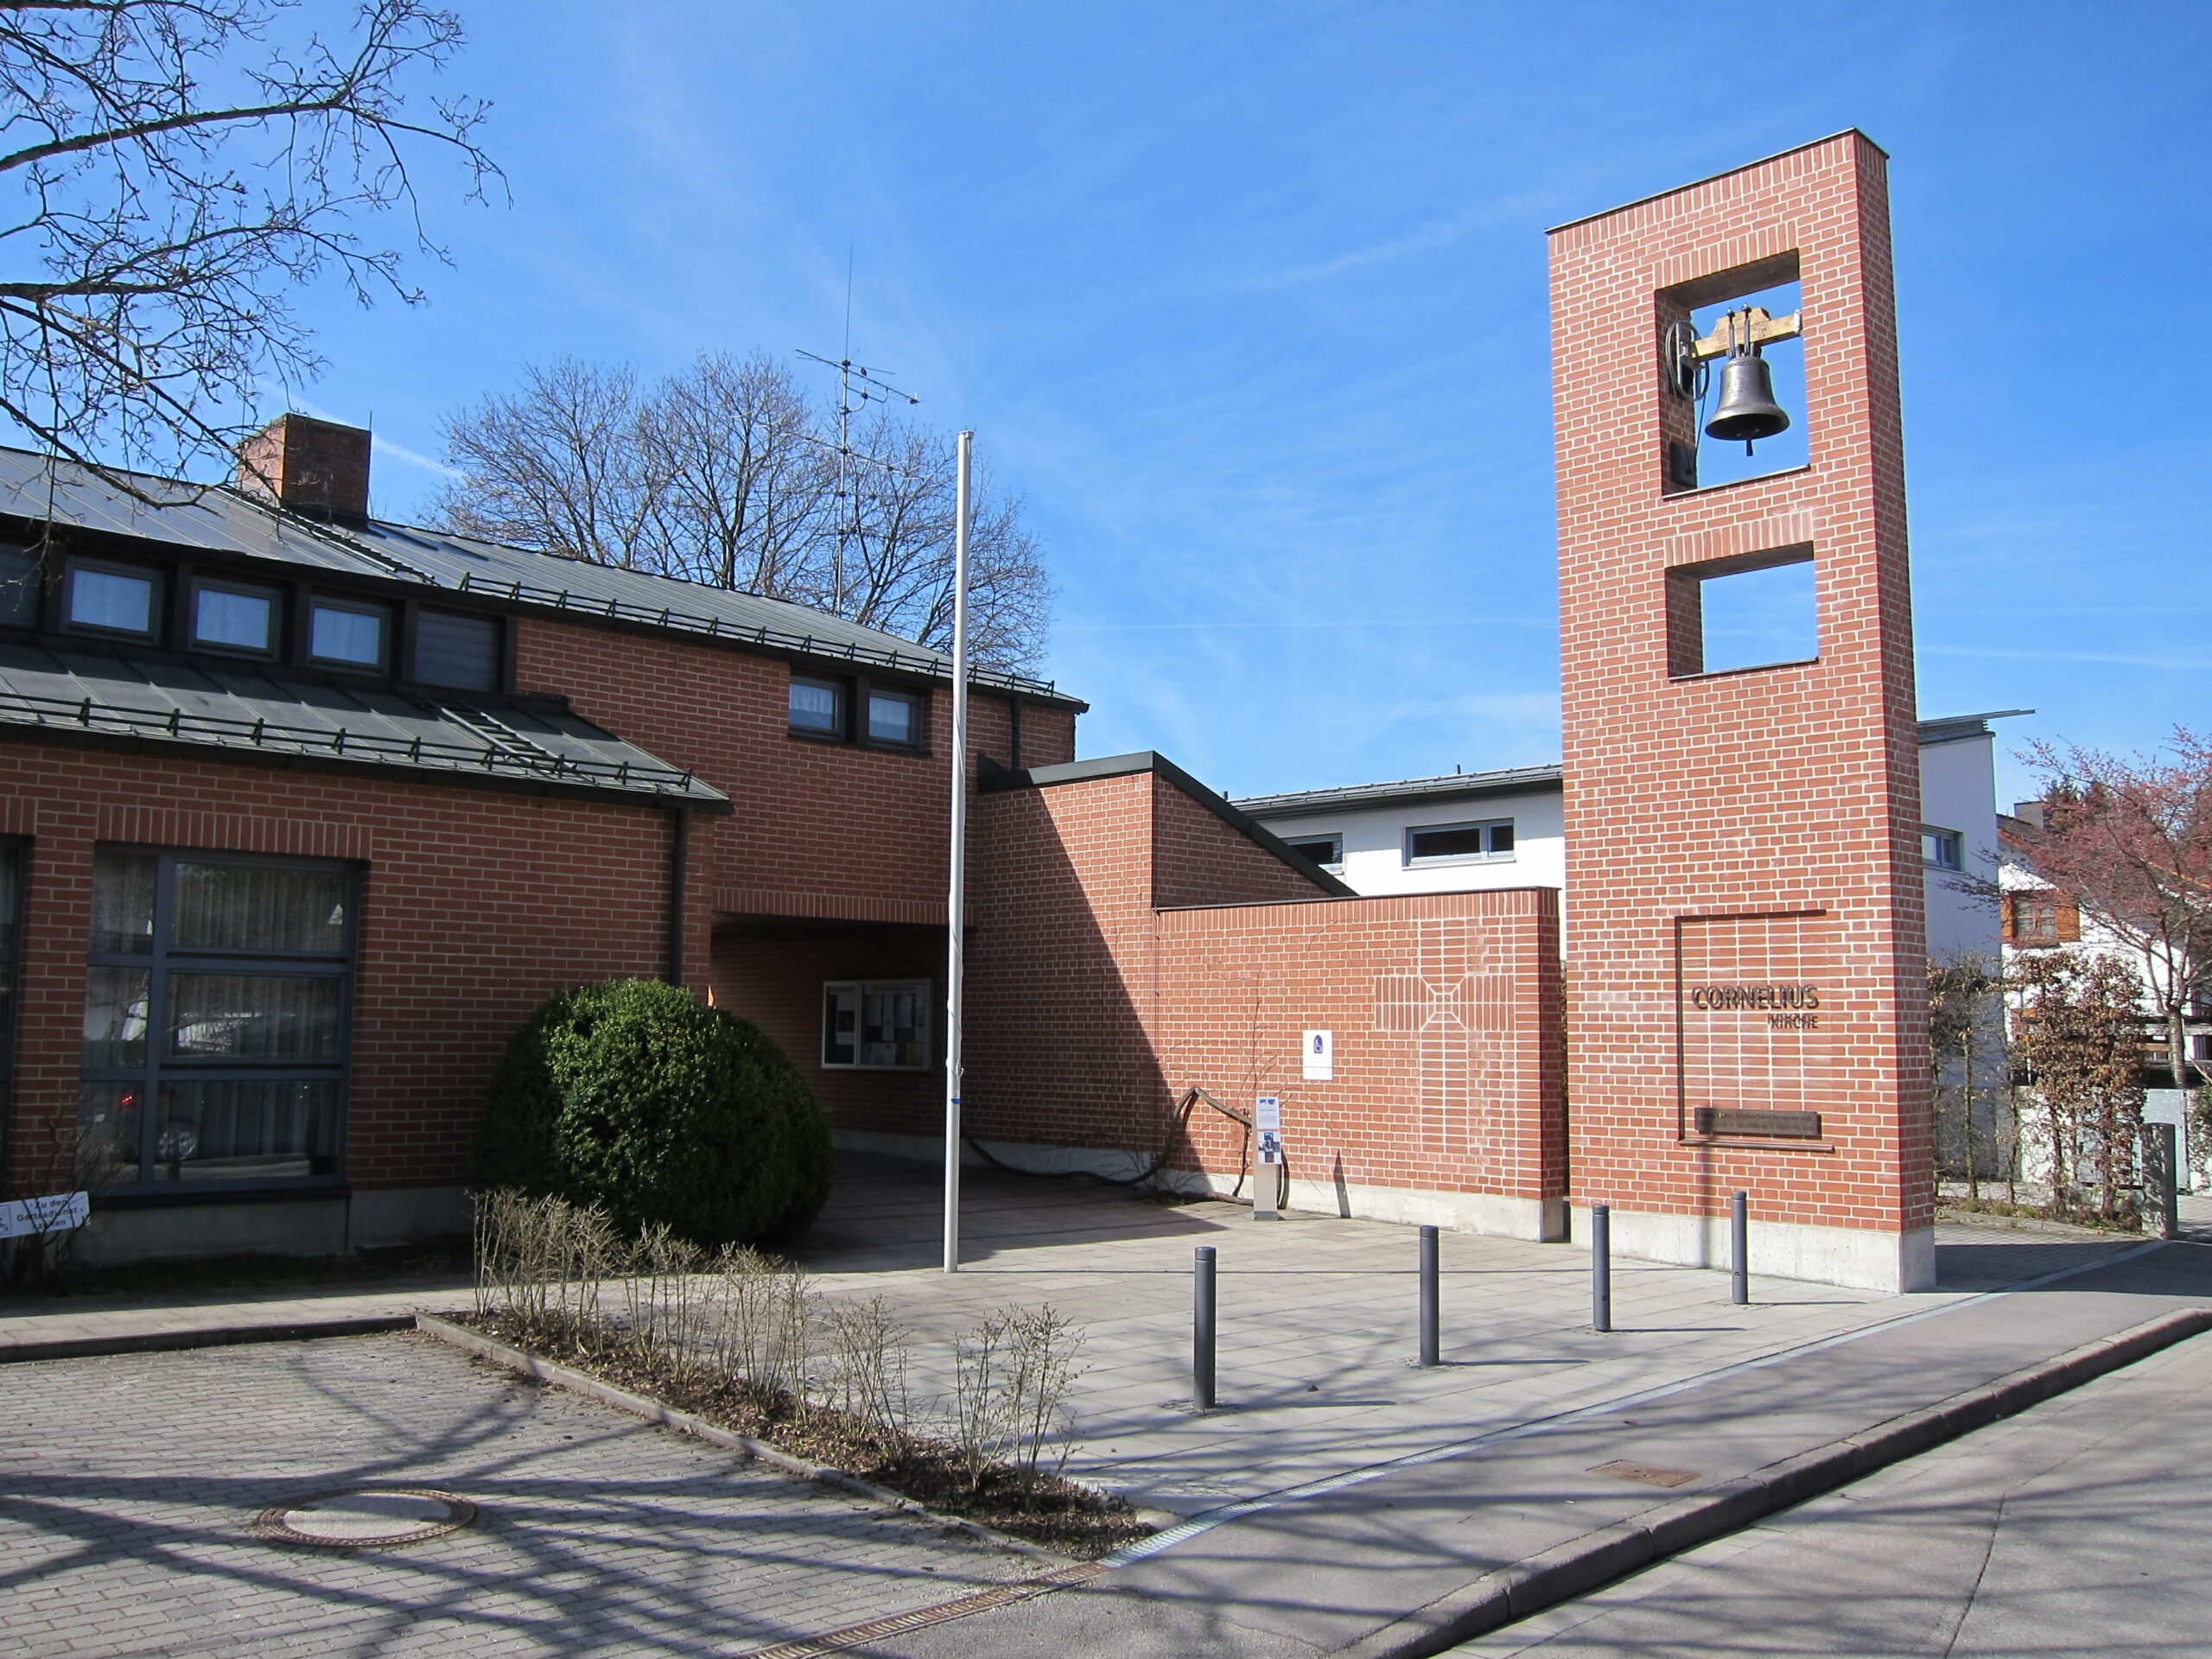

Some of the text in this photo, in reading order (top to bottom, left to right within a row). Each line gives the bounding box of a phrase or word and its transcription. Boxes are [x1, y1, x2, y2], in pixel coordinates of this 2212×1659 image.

[1692, 984, 1819, 1009] CORNELIUS
[1768, 1013, 1819, 1028] KIRCHE
[38, 1218, 67, 1229] zen
